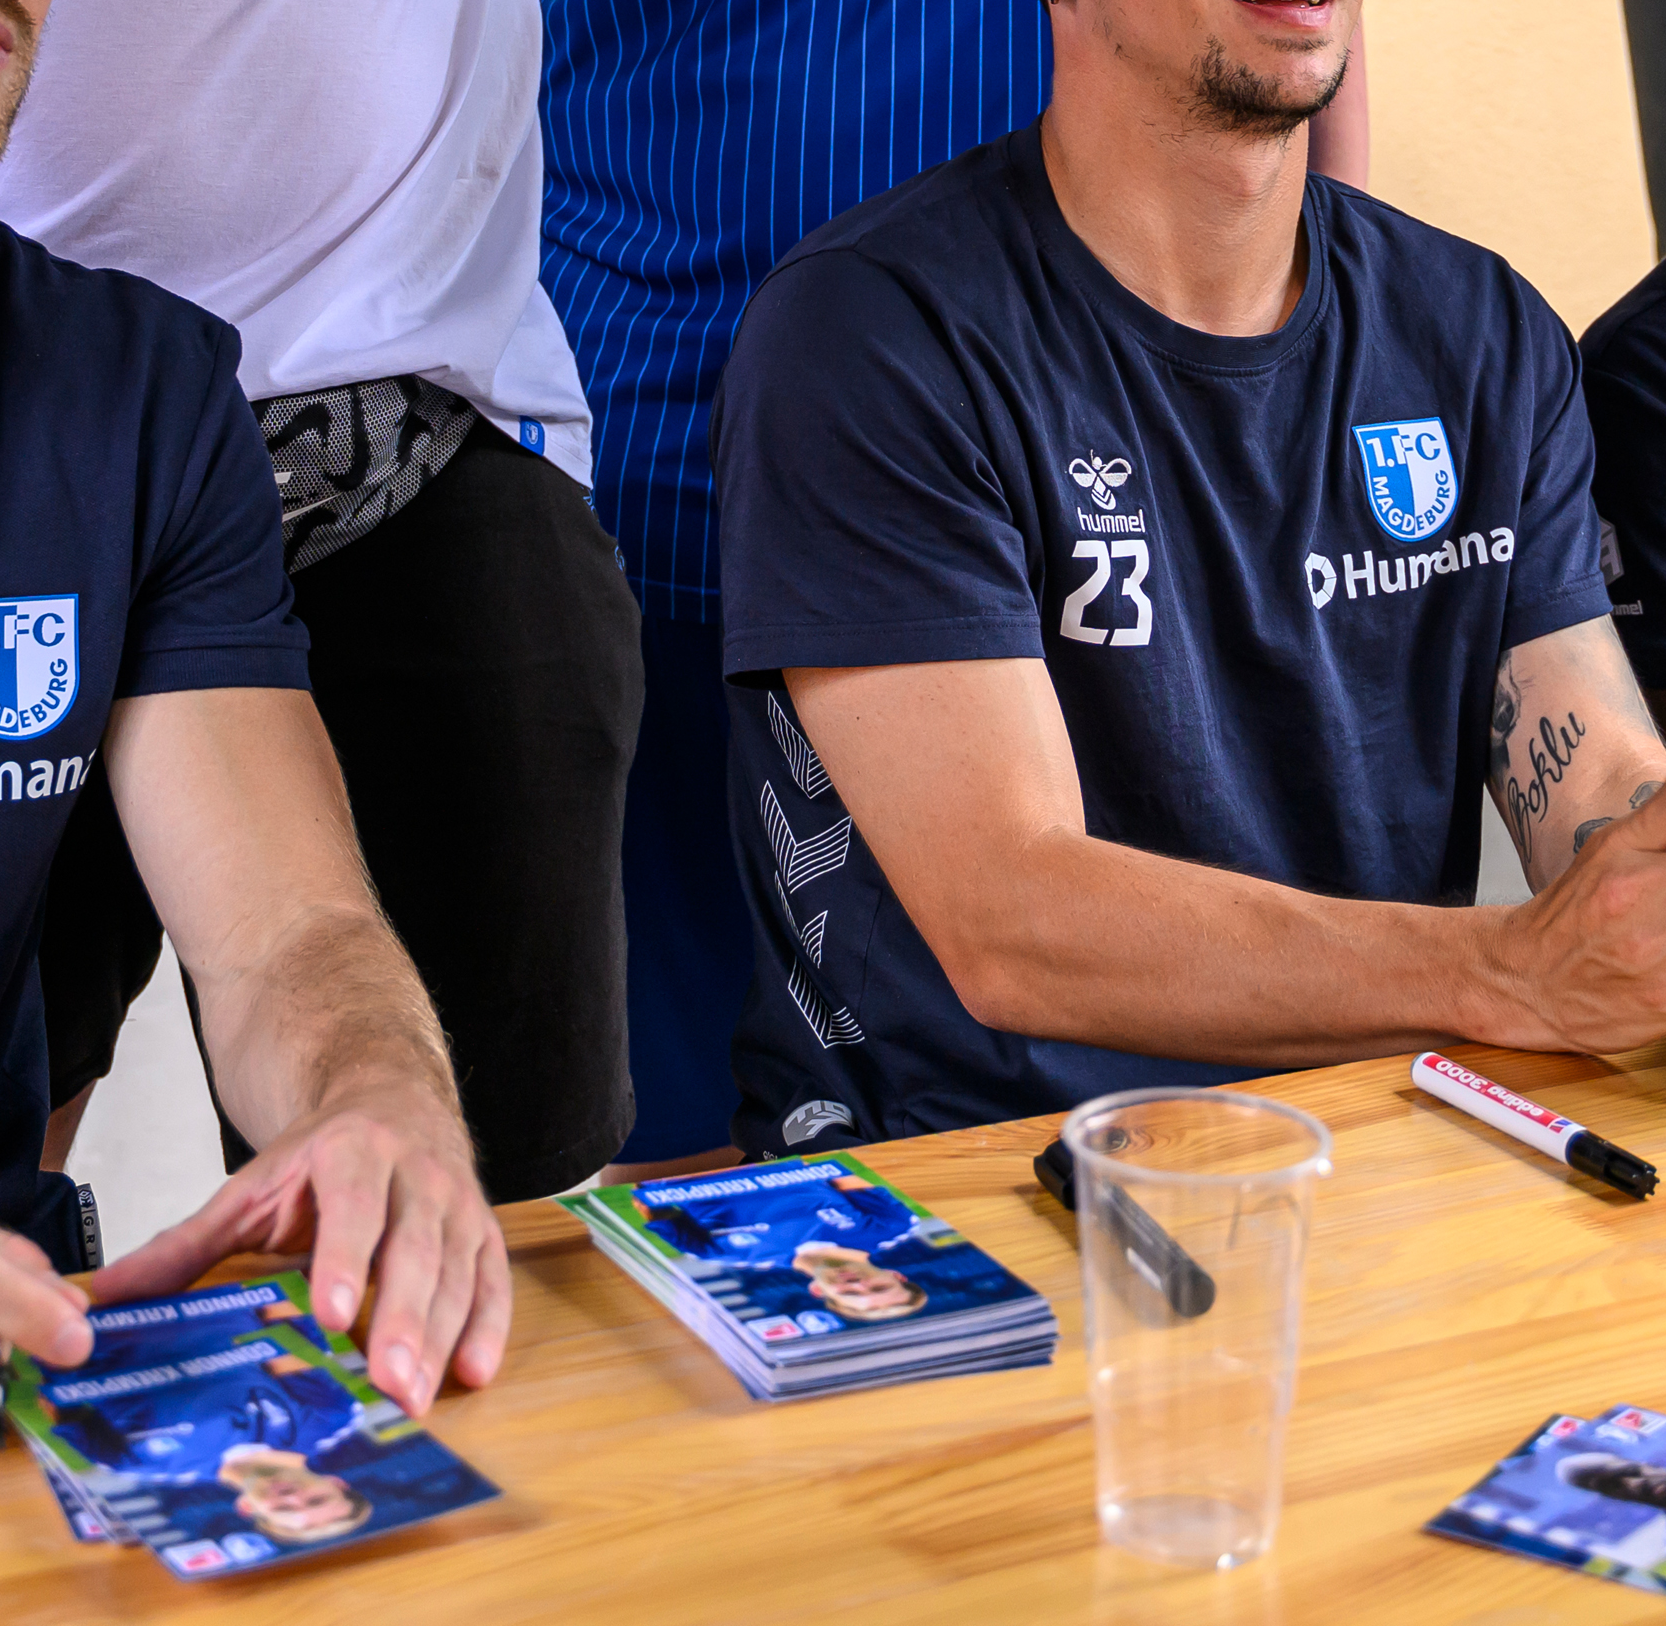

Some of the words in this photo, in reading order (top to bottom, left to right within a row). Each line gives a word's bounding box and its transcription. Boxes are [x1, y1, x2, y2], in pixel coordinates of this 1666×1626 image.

[1371, 470, 1451, 534] MAGDEBURG
[1076, 505, 1146, 534] hummel
[1059, 539, 1154, 647] 23
[1435, 1060, 1489, 1090] 3000
[1487, 1084, 1545, 1117] edding
[644, 1177, 760, 1205] KREMPICKI
[754, 1163, 843, 1189] CONNOR
[180, 1286, 278, 1318] CONNOR
[89, 1304, 179, 1332] KREMPI
